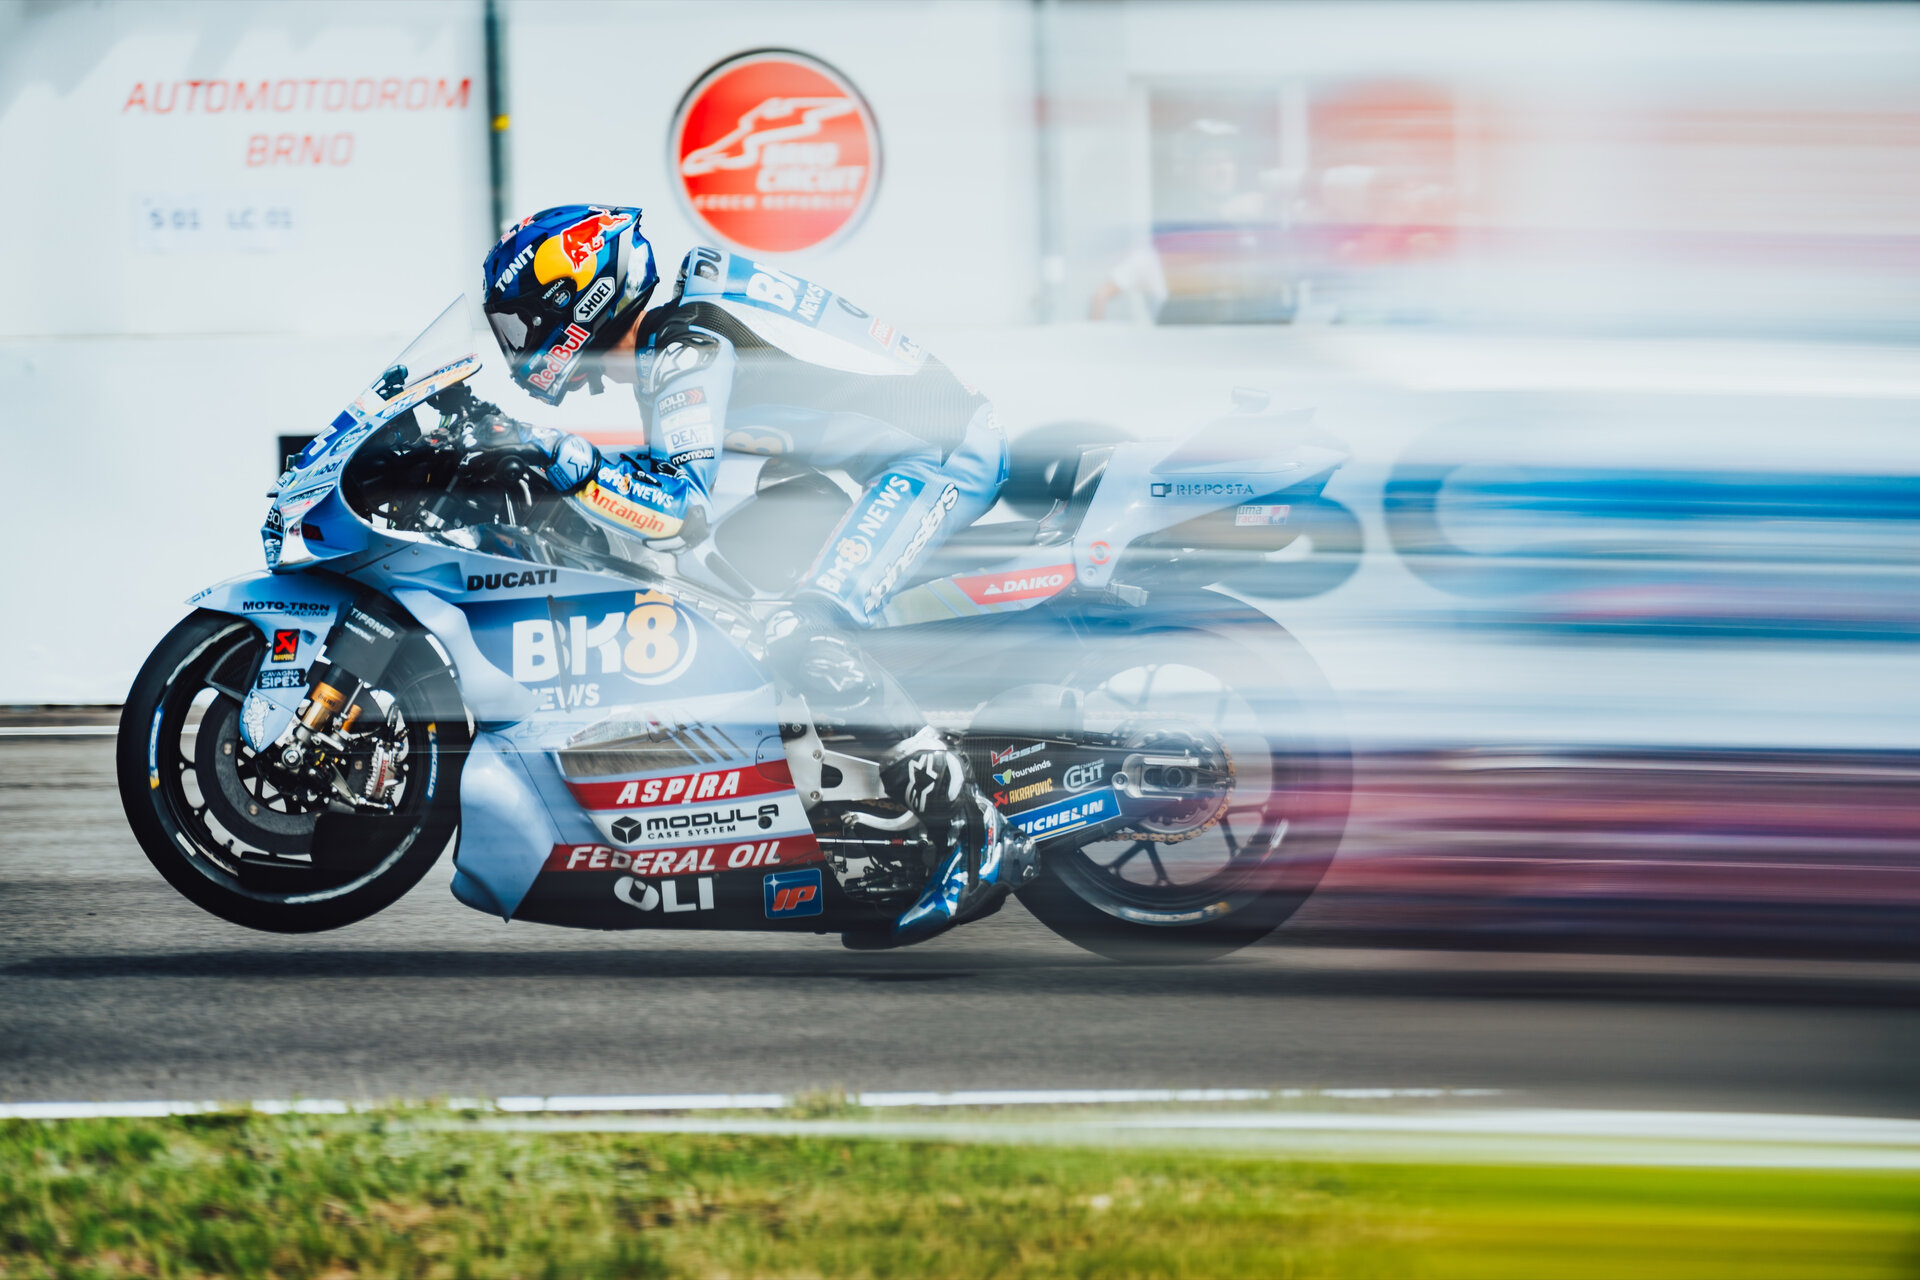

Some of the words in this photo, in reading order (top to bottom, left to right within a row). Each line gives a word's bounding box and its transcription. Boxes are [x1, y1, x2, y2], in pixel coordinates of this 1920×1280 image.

[122, 77, 471, 114] AUTOMOTODROM
[245, 133, 353, 167] BRNO
[579, 282, 612, 318] SHOEI
[632, 483, 674, 509] NEWS
[1176, 483, 1255, 496] RISPOSTA
[585, 488, 665, 533] Antangin
[857, 476, 911, 538] NEWS
[467, 569, 557, 591] DUCATI
[1002, 574, 1064, 593] DAIKO
[242, 601, 330, 611] MOTO-TRON
[513, 600, 688, 683] BK8
[261, 676, 300, 689] SIPEX
[1011, 760, 1052, 779] fourwinds
[616, 771, 741, 804] ASPIRA
[647, 804, 779, 831] MODULA
[648, 831, 680, 840] CASE
[688, 825, 736, 837] SYSTEM
[567, 846, 715, 875] FEDERAL
[727, 841, 781, 868] OIL
